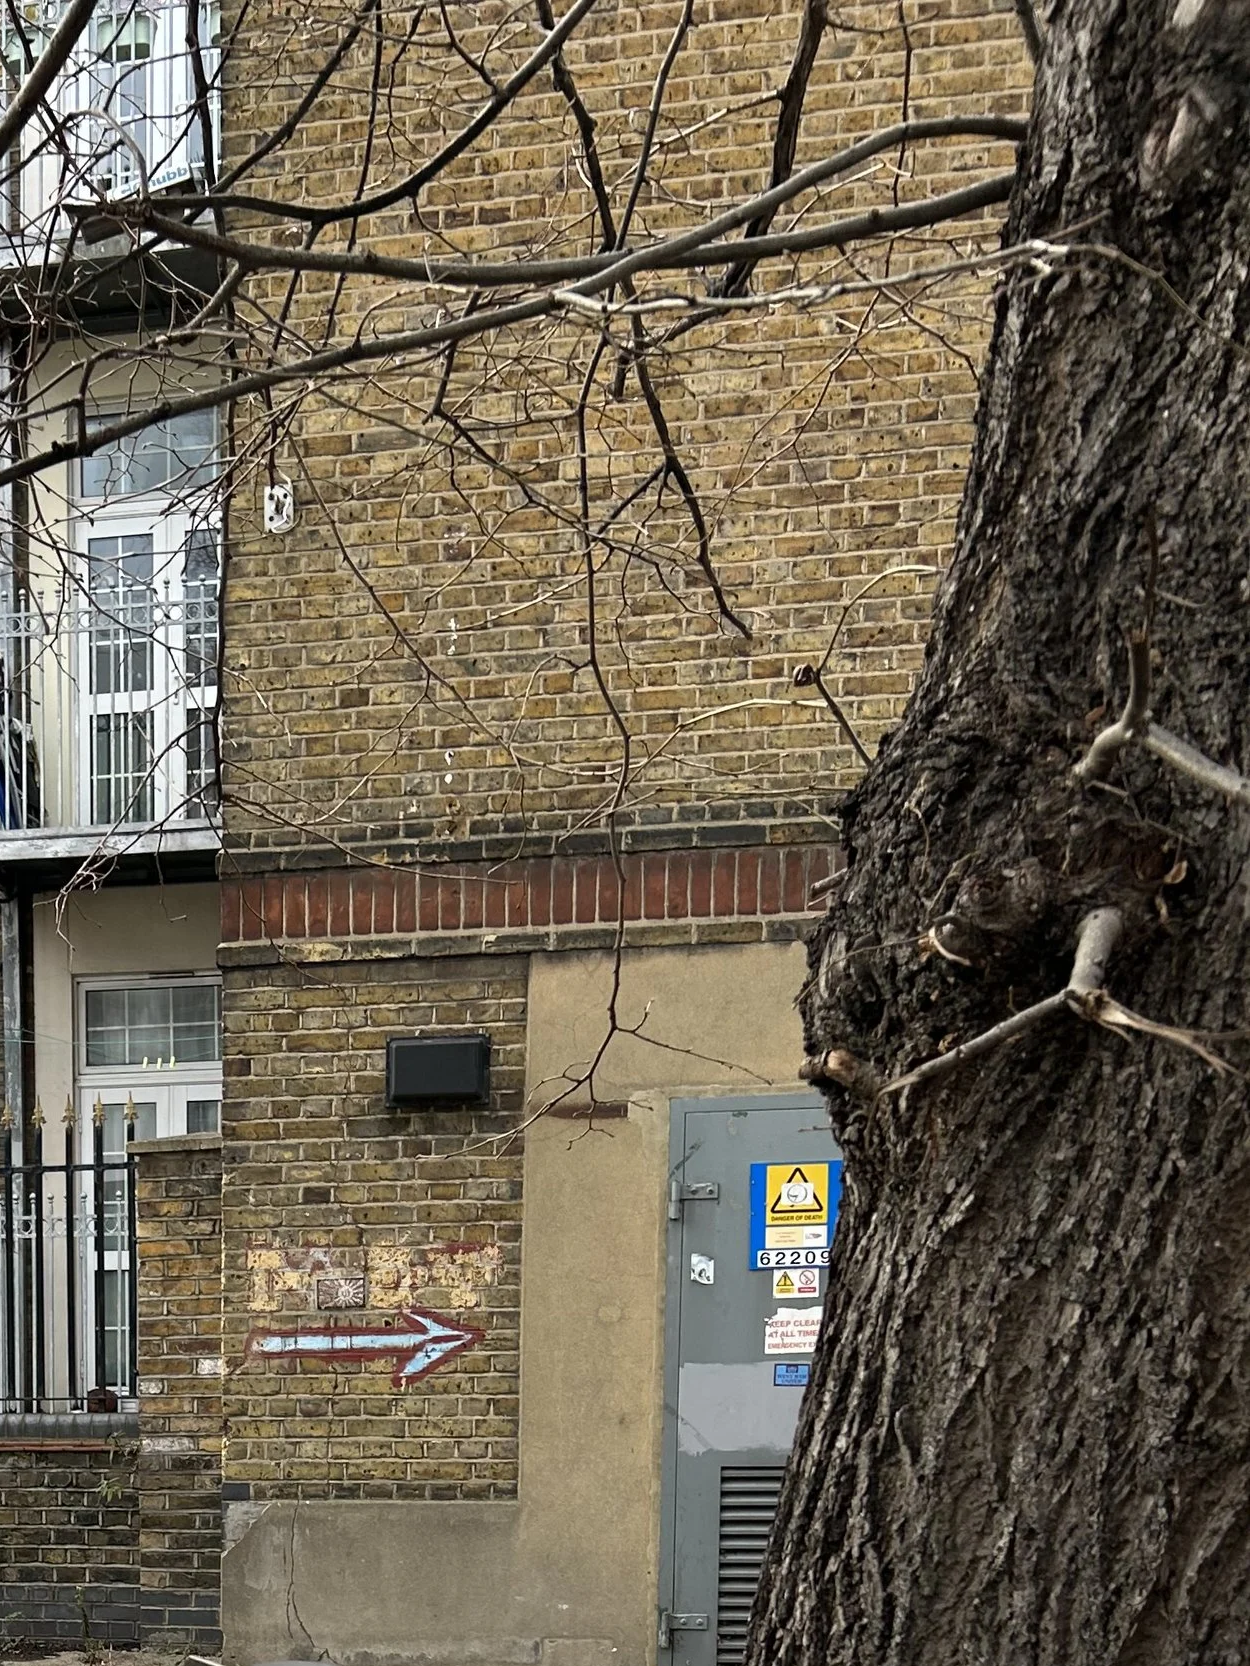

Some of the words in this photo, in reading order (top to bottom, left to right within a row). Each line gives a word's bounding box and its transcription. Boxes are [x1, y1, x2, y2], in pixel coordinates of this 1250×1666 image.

[759, 1250, 830, 1266] 62209
[768, 1330, 778, 1338] AT
[779, 1330, 796, 1338] ALL
[797, 1329, 819, 1337] TIME
[767, 1341, 807, 1349] EMERGENCY
